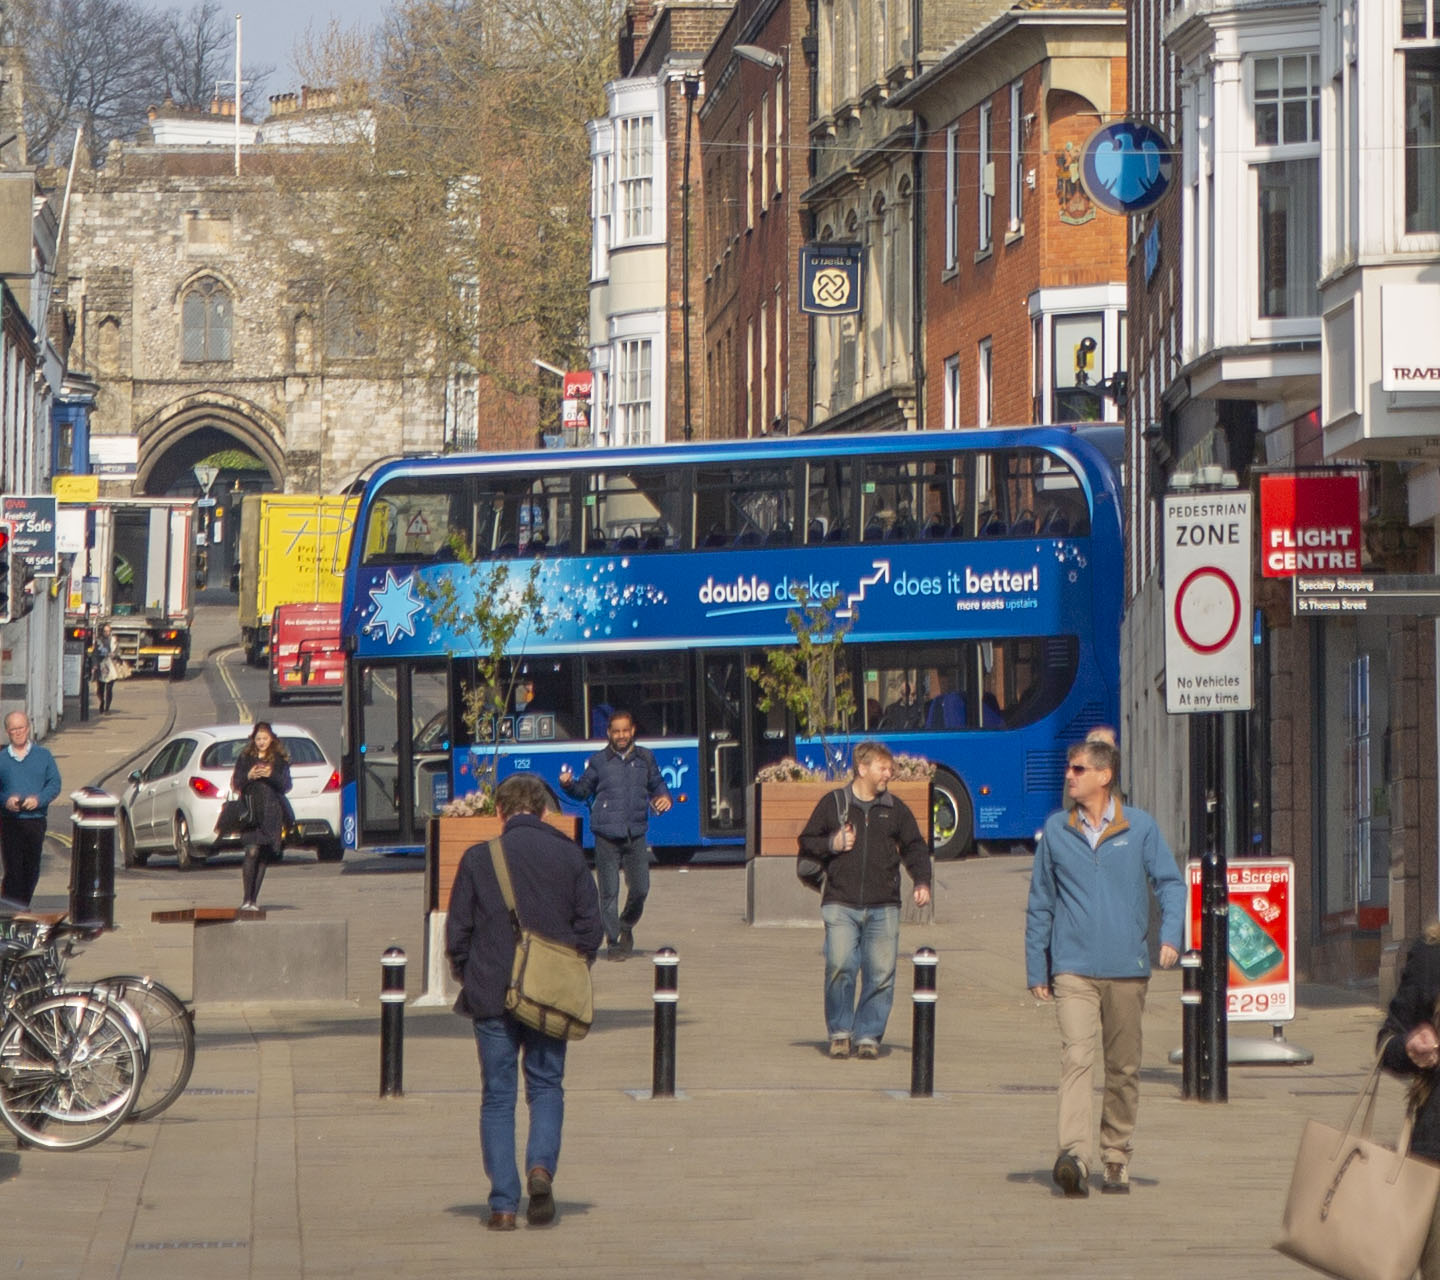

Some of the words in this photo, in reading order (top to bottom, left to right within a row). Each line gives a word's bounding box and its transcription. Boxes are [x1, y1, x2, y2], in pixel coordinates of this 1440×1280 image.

[1168, 503, 1247, 519] PEDESTRIAN
[26, 519, 53, 533] Sale
[1176, 523, 1240, 547] ZONE
[1270, 529, 1353, 548] FLIGHT
[1268, 551, 1357, 570] CENTRE
[893, 570, 942, 596] does
[947, 570, 961, 594] it
[965, 566, 1040, 594] better!
[1337, 578, 1374, 592] Shopping
[698, 576, 769, 604] double
[956, 600, 980, 611] more
[981, 599, 1004, 610] seats
[1005, 598, 1038, 610] upstairs
[1298, 599, 1308, 610] St
[1308, 598, 1340, 610] Thomas
[1341, 599, 1367, 610] Street
[1177, 676, 1193, 689] No
[1195, 675, 1240, 688] Vehicles
[1179, 693, 1191, 705] At
[1193, 695, 1212, 707] any
[1215, 692, 1239, 704] time
[514, 759, 531, 769] 1252
[1242, 870, 1289, 884] Screen
